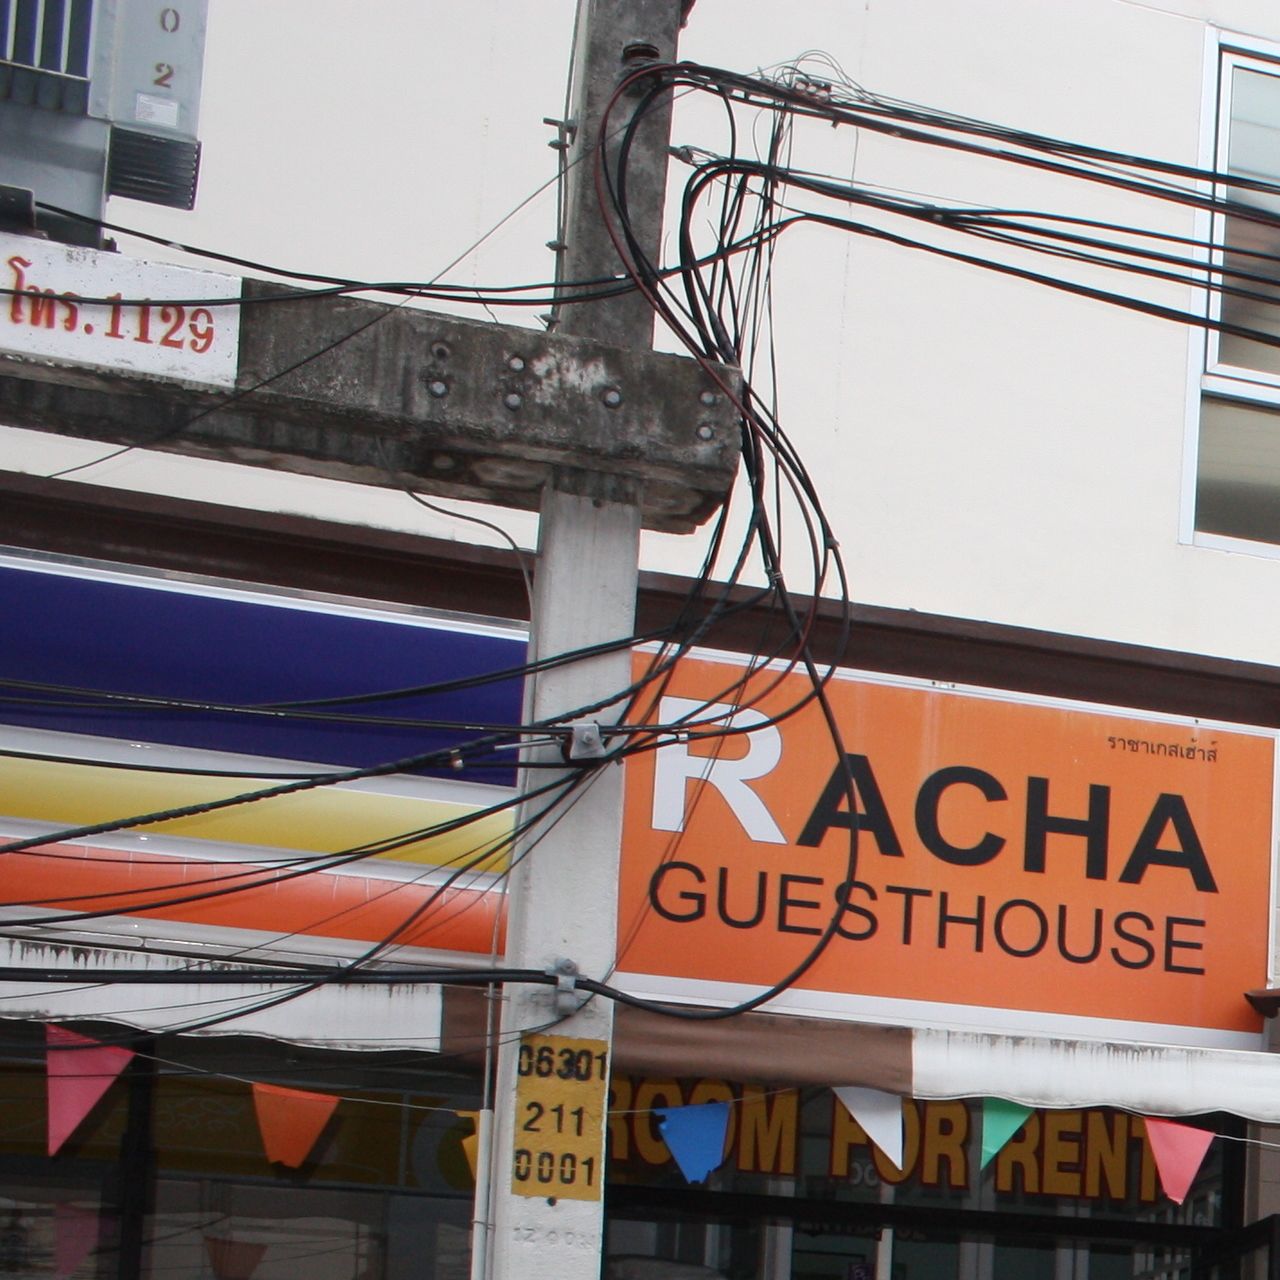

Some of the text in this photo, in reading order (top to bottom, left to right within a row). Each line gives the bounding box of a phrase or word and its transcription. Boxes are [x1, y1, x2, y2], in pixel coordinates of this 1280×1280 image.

[652, 695, 1219, 894] RACHA
[648, 861, 1206, 976] GUESTHOUSE
[522, 1102, 584, 1137] 211
[514, 1148, 594, 1187] 0001
